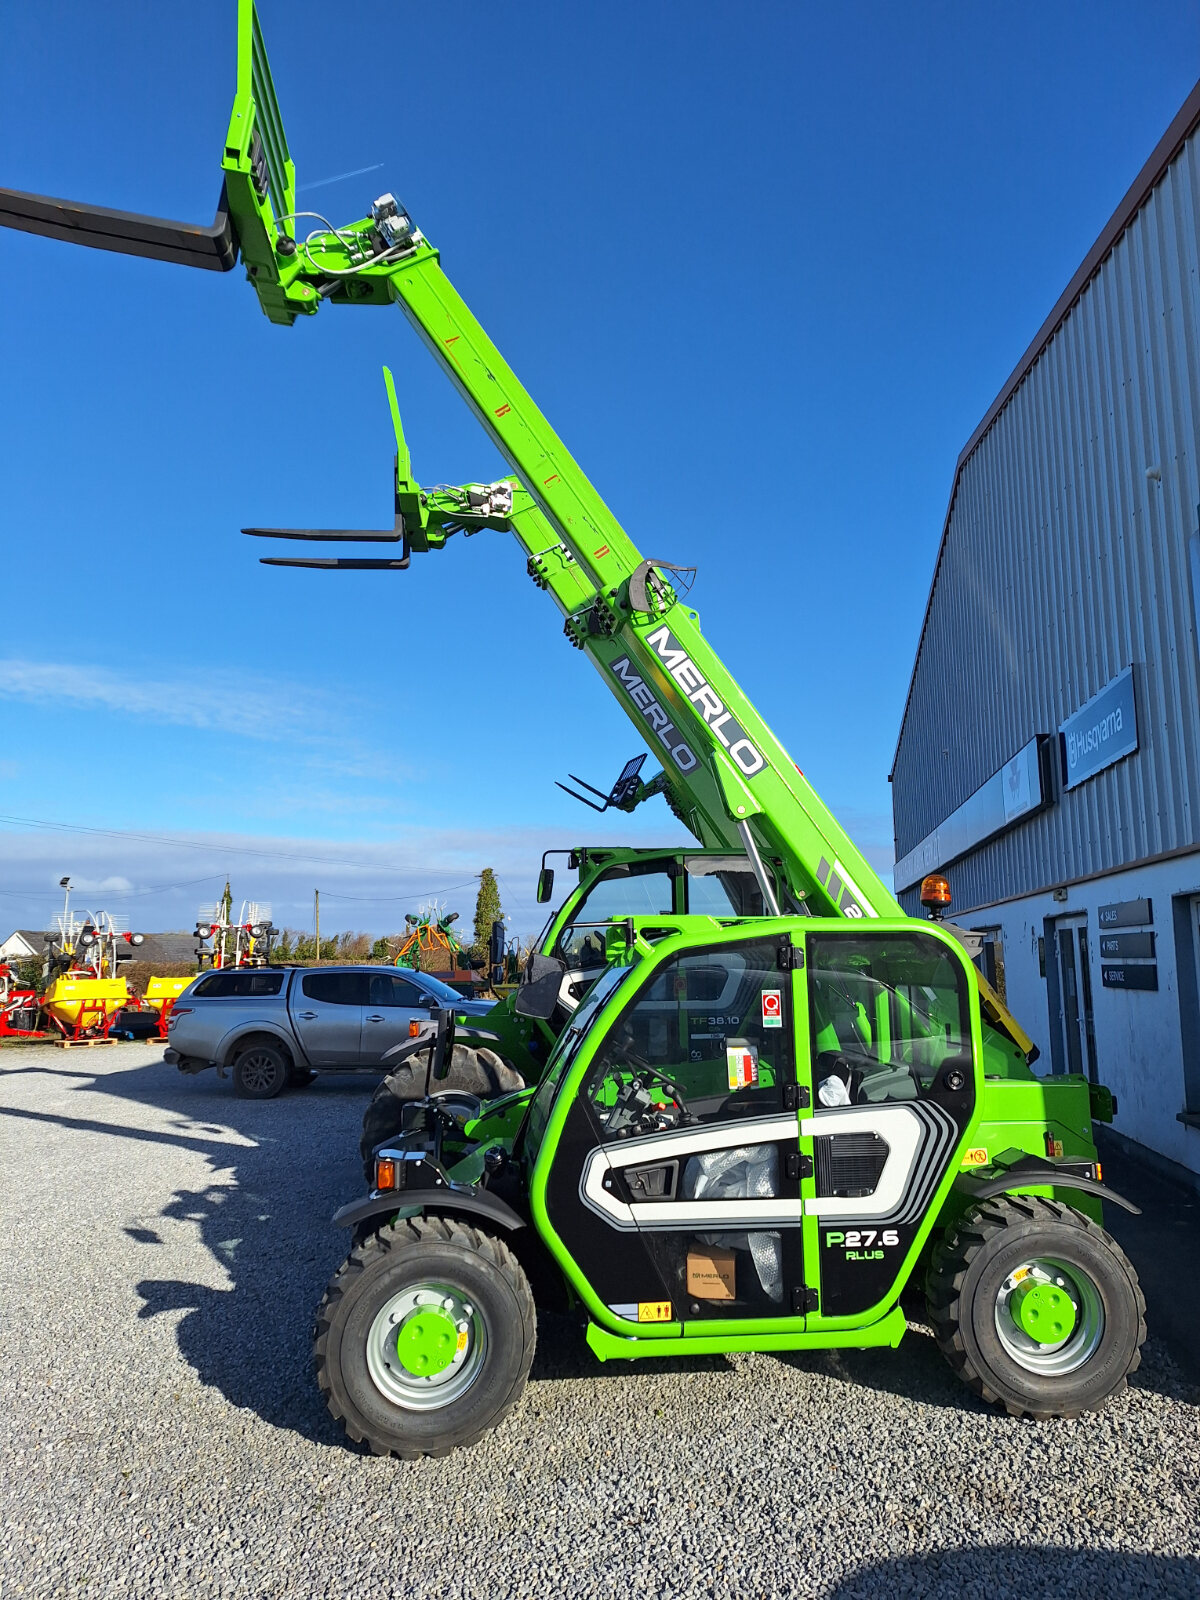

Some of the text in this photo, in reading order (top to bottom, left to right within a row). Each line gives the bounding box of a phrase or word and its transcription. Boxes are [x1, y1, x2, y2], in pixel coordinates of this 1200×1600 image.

[494, 403, 511, 418] B
[543, 474, 561, 489] C
[593, 544, 610, 560] D
[646, 626, 764, 775] MERLO
[612, 657, 697, 771] MERLO
[1076, 707, 1123, 758] Husqvarna
[1105, 910, 1117, 921] SALES
[1106, 940, 1119, 951] PARTS
[1108, 970, 1125, 982] SERVICE
[690, 1016, 740, 1025] TF38.10
